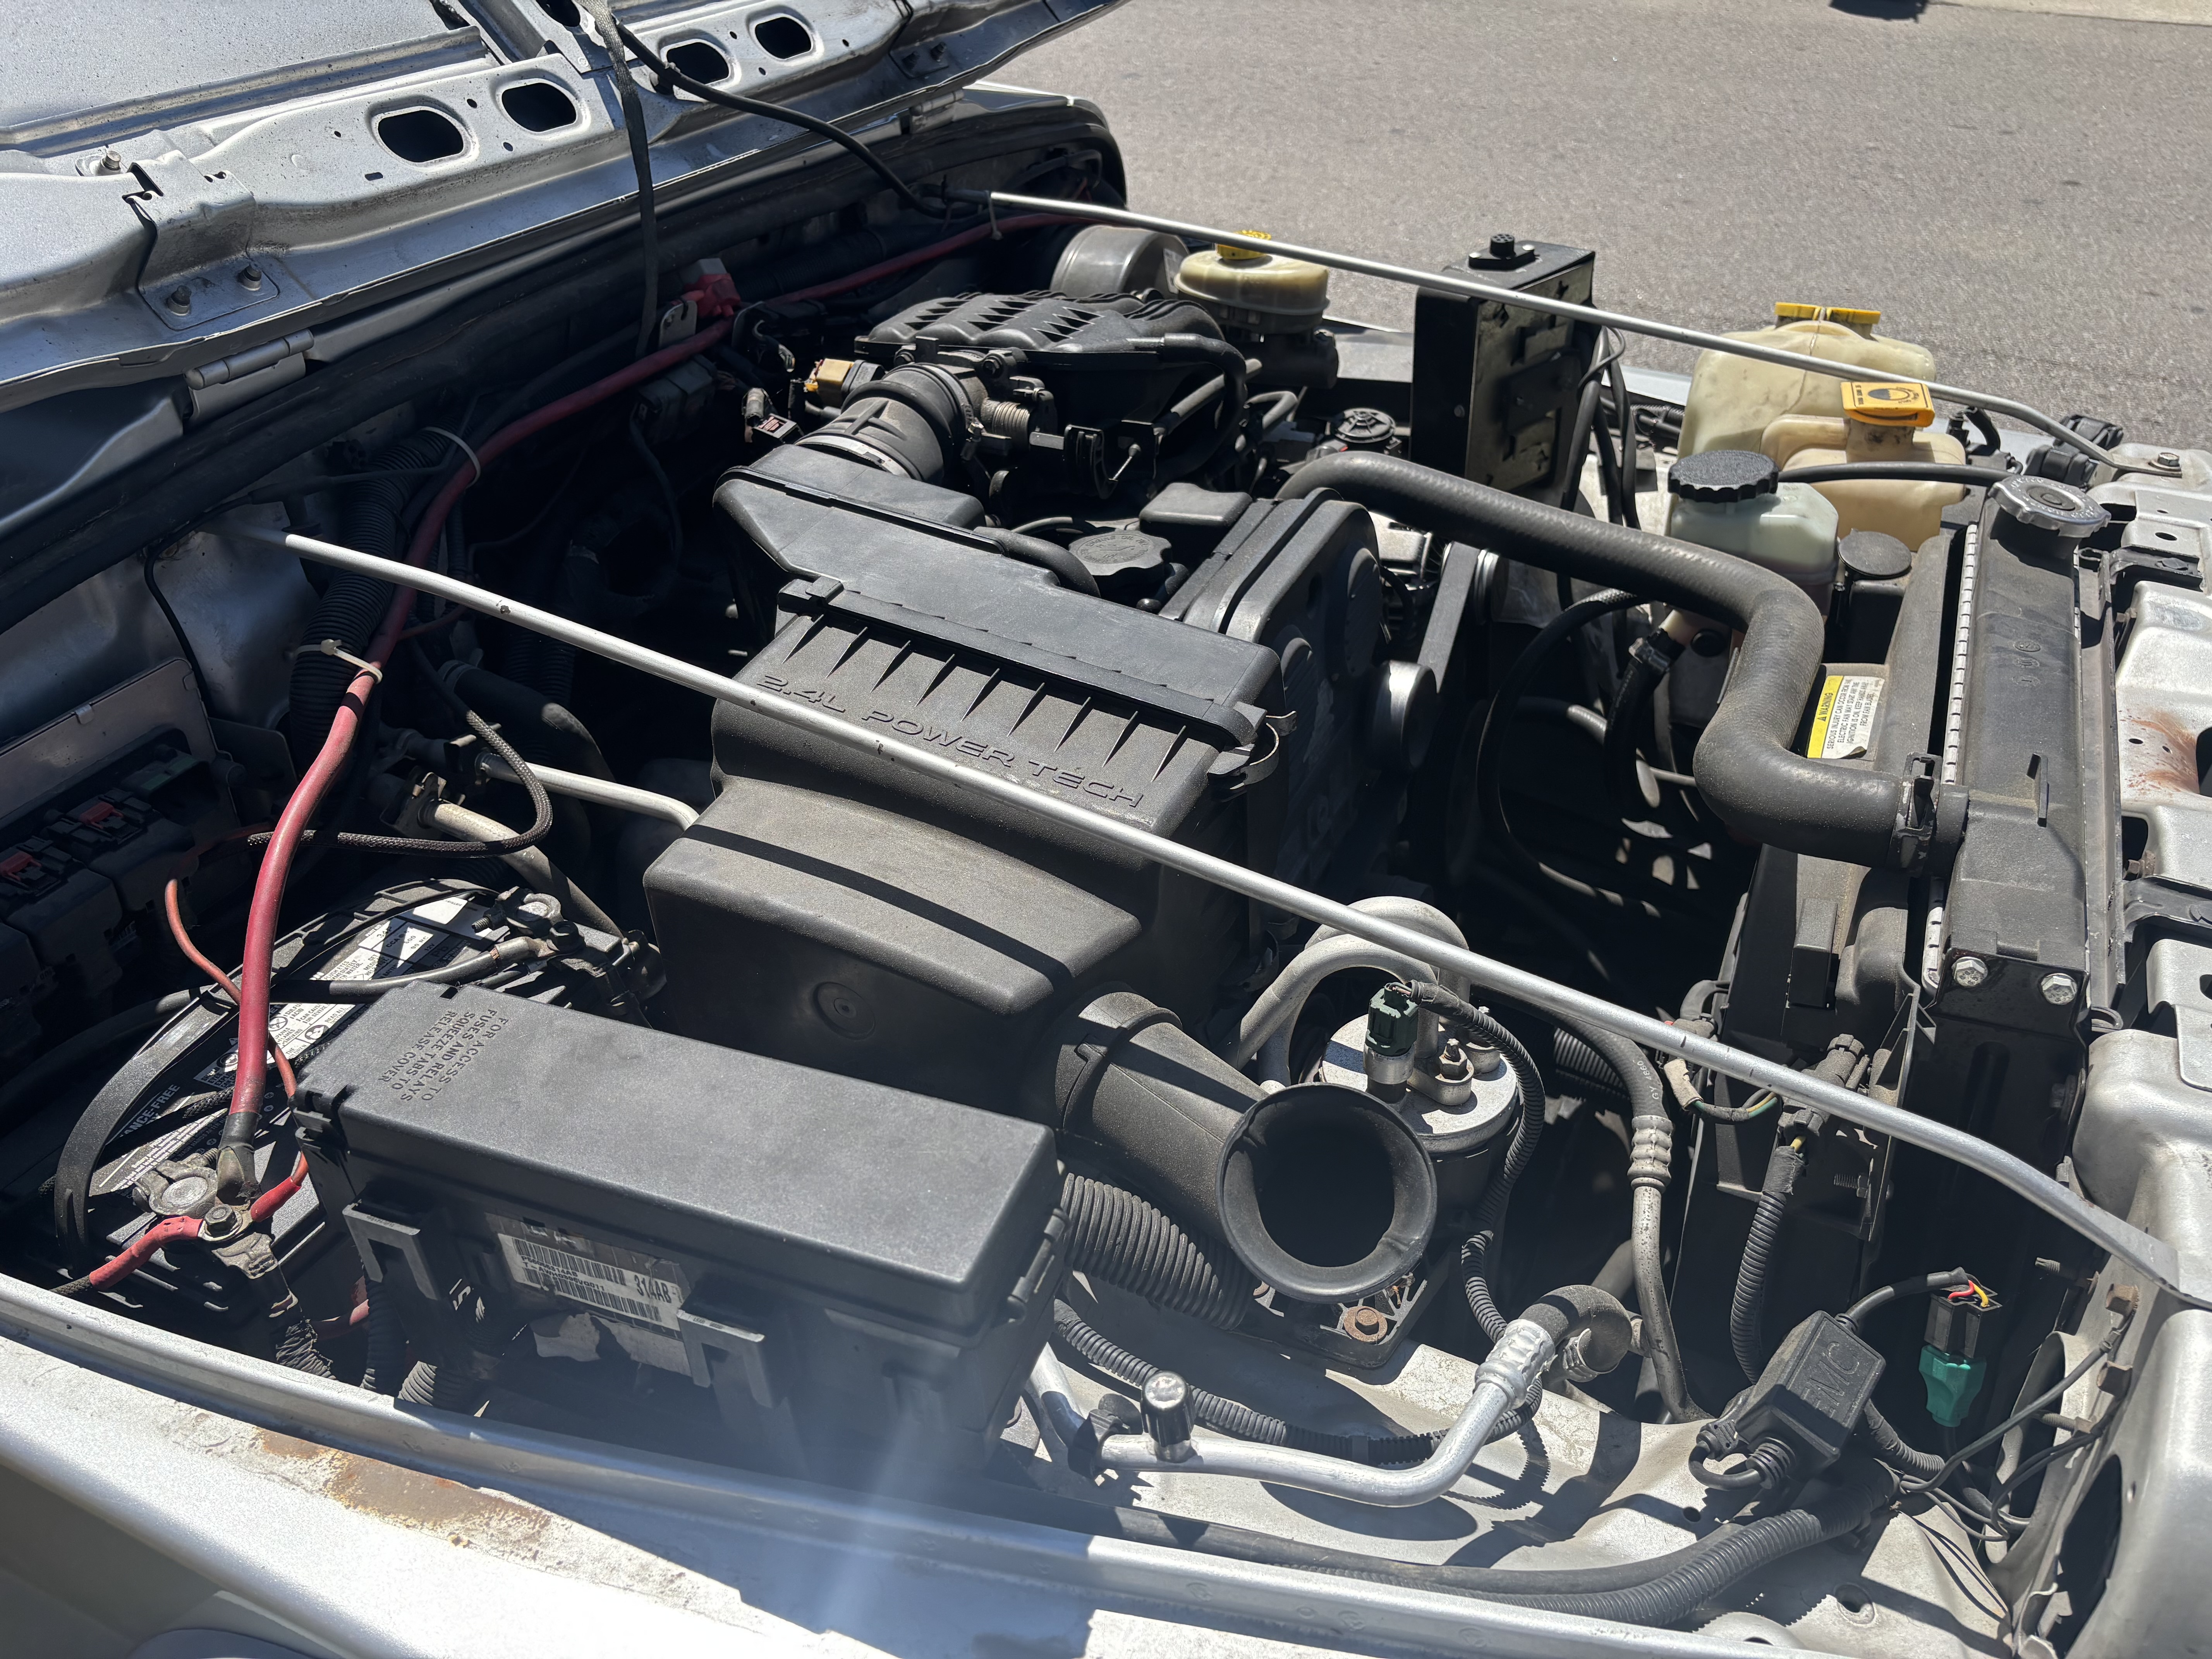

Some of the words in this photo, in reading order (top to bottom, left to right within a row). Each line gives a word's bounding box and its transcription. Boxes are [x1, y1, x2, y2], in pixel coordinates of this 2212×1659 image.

[1819, 692, 1833, 715] WARNING
[1860, 714, 1868, 726] FROM
[756, 674, 846, 714] 2.4L
[861, 710, 1014, 767] POWER
[1029, 759, 1147, 807] TECH
[1827, 730, 1836, 749] SERIOUS
[1838, 723, 1848, 742] ELECTRIC
[1846, 723, 1857, 744] IGNITION
[386, 938, 400, 946] CCA
[292, 1008, 304, 1017] ACID
[411, 1010, 457, 1051] RELEASE
[431, 1012, 475, 1050] SQUEEZE
[462, 1009, 496, 1041] FUSES
[482, 1017, 508, 1039] FOR
[441, 1041, 464, 1061] AND
[378, 1050, 415, 1082] COVER
[405, 1052, 436, 1077] TABS
[438, 1040, 484, 1085] ACCESS
[1637, 1060, 1652, 1081] 4860
[391, 1077, 410, 1091] TO
[400, 1062, 444, 1102] RELAYS
[420, 1087, 441, 1102] TO
[1649, 1086, 1659, 1100] GY
[191, 1132, 208, 1146] HANDS
[131, 1156, 148, 1168] Battery
[635, 1274, 671, 1304] 314AB
